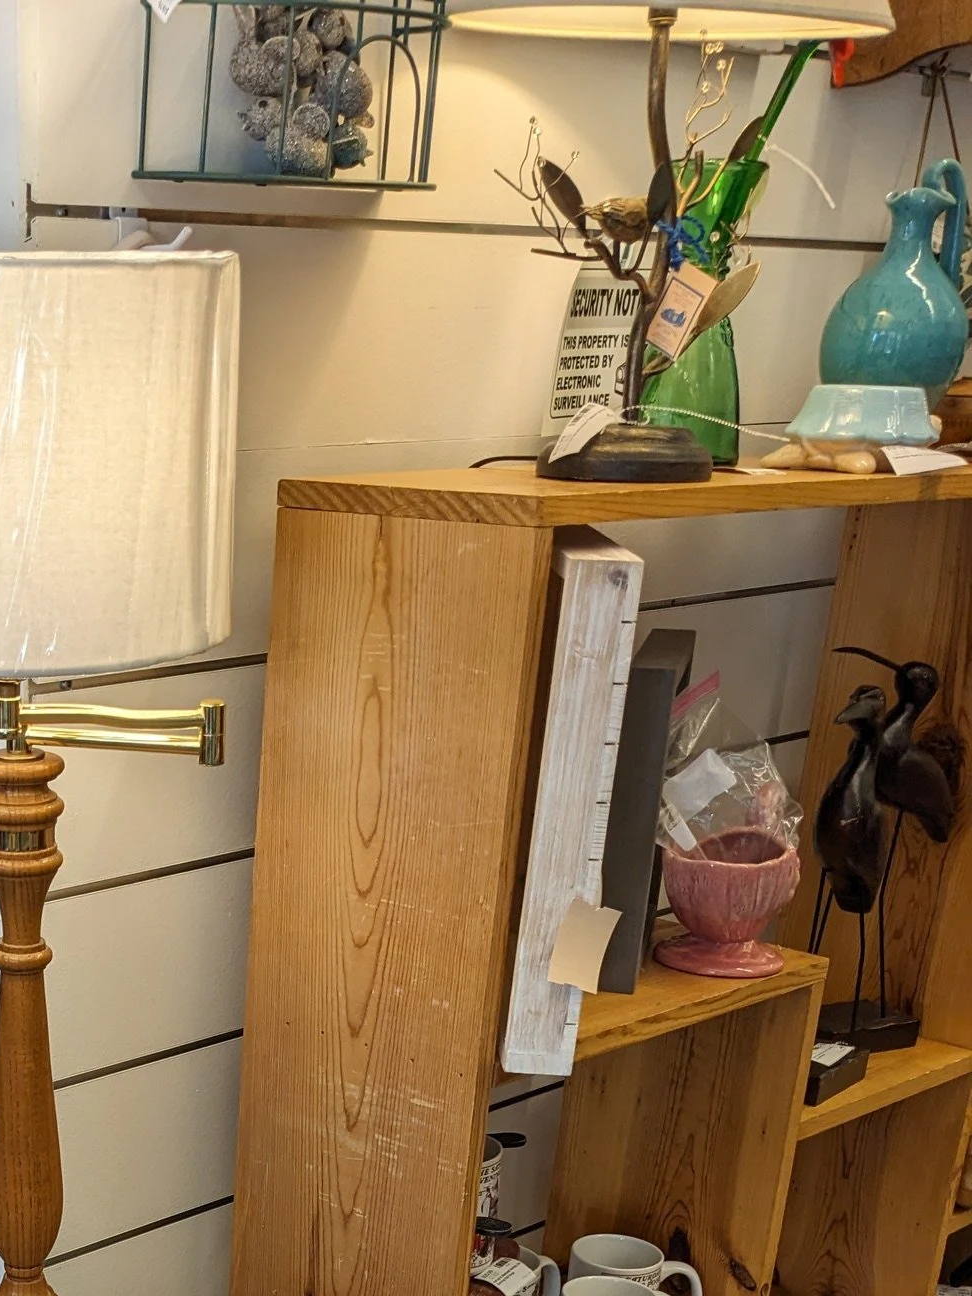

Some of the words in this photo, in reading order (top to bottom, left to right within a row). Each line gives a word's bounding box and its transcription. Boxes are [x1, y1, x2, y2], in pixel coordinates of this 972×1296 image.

[570, 288, 614, 318] SECURITY
[562, 335, 577, 350] THIS
[577, 334, 619, 350] PROPERTY
[620, 334, 630, 348] IS
[559, 355, 600, 371] PROTECTED
[602, 354, 614, 368] BY
[556, 374, 602, 391] ELECTRONIC
